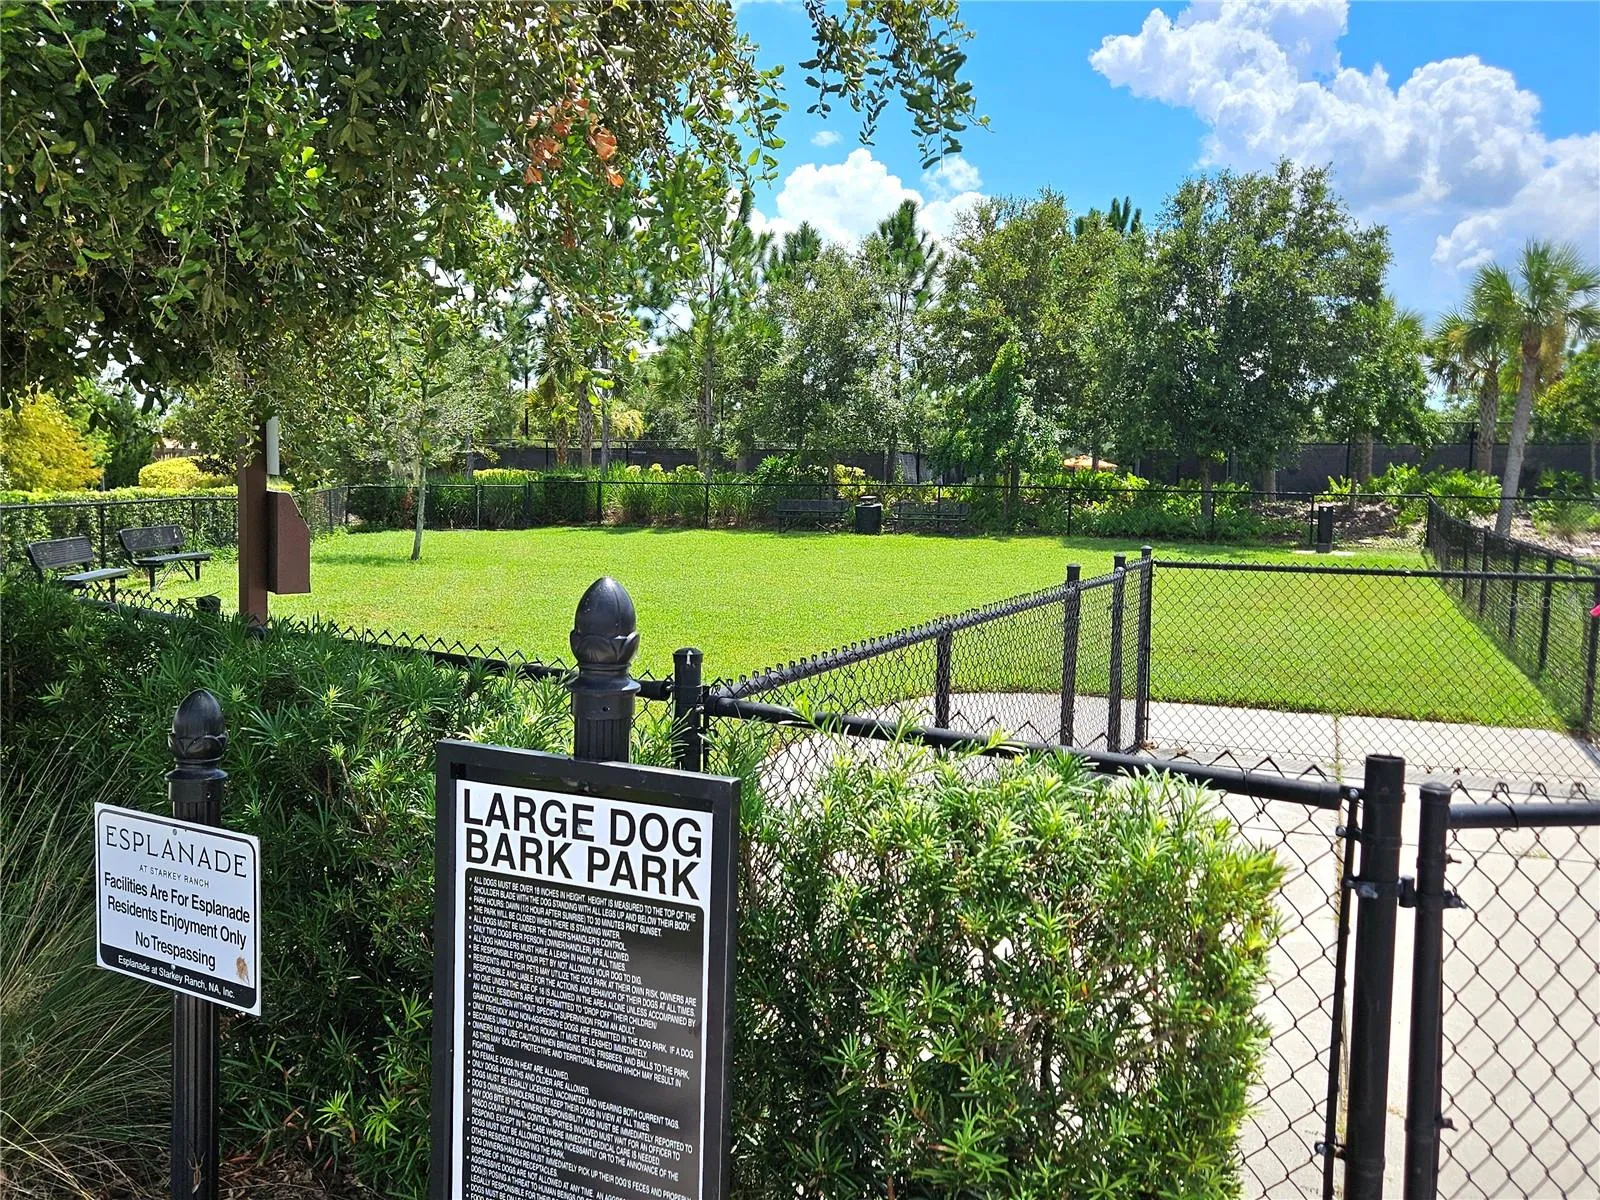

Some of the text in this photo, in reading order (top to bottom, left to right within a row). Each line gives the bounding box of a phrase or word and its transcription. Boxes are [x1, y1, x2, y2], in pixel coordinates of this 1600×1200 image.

[464, 789, 701, 858] LARGE DOG
[106, 825, 247, 878] ESPLANADE
[467, 828, 699, 900] BARK PARK
[139, 864, 209, 888] AT STARKEY RANCH
[105, 872, 250, 923] Facilities Are For Esplanade
[474, 877, 483, 885] ALL
[483, 878, 497, 888] DOGS
[498, 881, 511, 890] MUST
[512, 883, 519, 891] BE
[519, 884, 533, 894] OVER
[541, 888, 559, 898] INCHES
[560, 891, 565, 899] IN
[588, 896, 607, 906] HEIGHT
[608, 899, 613, 907] IS
[614, 900, 644, 912] MEASURED
[645, 905, 652, 914] TO
[653, 907, 664, 916] THE
[664, 908, 675, 918] TOP
[676, 910, 684, 919] OF
[685, 912, 696, 921] THE
[474, 886, 690, 931] SHOULDER BLADE WITH THE DOG STANDING WITH ALL LEGS UP AND BELOW THEIR BODY.
[474, 896, 486, 905] PARK
[506, 902, 519, 911] DAWN
[530, 906, 544, 915] HOUR
[545, 908, 561, 919] AFTER
[562, 911, 586, 923] SUNRISE)
[587, 916, 594, 924] TO
[595, 917, 601, 925] 30
[602, 918, 625, 930] MINUTES
[626, 923, 639, 932] PAST
[640, 925, 662, 936] SUNSET.
[108, 895, 247, 950] Residents Enjoyment Only
[473, 915, 482, 924] ALL
[483, 917, 497, 926] DOGS
[498, 920, 511, 929] MUST
[512, 922, 518, 930] BE
[519, 924, 536, 934] UNDER
[537, 927, 547, 936] THE
[473, 925, 486, 934] ONLY
[486, 927, 497, 936] TWO
[498, 929, 512, 939] DOGS
[513, 932, 523, 941] PER
[524, 934, 544, 945] PERSON
[592, 947, 603, 956] ARE
[474, 905, 621, 939] THE PARK WILL BE CLOSED WHEN THERE IS STANDING WATER.
[136, 931, 215, 971] No Trespassing
[473, 934, 482, 943] ALL
[483, 936, 493, 945] DOG
[494, 938, 519, 950] HANDLERS
[520, 943, 534, 953] MUST
[535, 946, 548, 956] HAVE
[549, 949, 553, 957] A
[554, 950, 570, 960] LEASH
[571, 953, 576, 961] IN
[577, 954, 591, 964] HAND
[592, 957, 598, 966] AT
[599, 959, 609, 968] ALL
[473, 944, 479, 952] BE
[480, 945, 513, 959] RESPONSIBLE
[514, 952, 524, 961] FOR
[525, 954, 538, 964] YOUR
[539, 957, 549, 966] PET
[550, 959, 557, 968] BY
[558, 961, 568, 970] NOT
[569, 963, 595, 975] ALLOWING
[595, 968, 609, 978] YOUR
[611, 971, 623, 981] DOG
[624, 973, 631, 982] TO
[118, 955, 235, 999] Esplanade at Starkey Ranch, NA, Inc.
[472, 1040, 495, 1052] FIGHTING.
[472, 1050, 479, 1058] NO
[480, 1052, 499, 1063] FEMALE
[500, 1056, 513, 1067] DOGS
[514, 1060, 519, 1068] IN
[520, 1061, 533, 1071] HEAT
[533, 1064, 543, 1074] ARE
[472, 1059, 484, 1069] ONLY
[485, 1062, 499, 1073] DOGS
[499, 1066, 502, 1074] 4
[503, 1067, 524, 1079] MONTHS
[525, 1072, 535, 1082] AND
[536, 1075, 552, 1086] OLDER
[553, 1079, 564, 1089] ARE
[472, 1069, 486, 1079] DOGS
[487, 1072, 500, 1083] MUST
[501, 1076, 507, 1085] BE
[508, 1078, 528, 1090] LEGALLY
[555, 1089, 586, 1104] VACCINATED
[587, 1097, 597, 1107] AND
[598, 1100, 622, 1113] WEARING
[623, 1106, 637, 1117] BOTH
[638, 1110, 664, 1124] CURRENT
[665, 1117, 680, 1128] TAGS.
[471, 1126, 487, 1138] OTHER
[488, 1131, 515, 1145] RESIDENTS
[516, 1138, 540, 1152] ENJOYING
[540, 1145, 550, 1155] THE
[471, 1145, 491, 1158] DISPOSE
[492, 1151, 499, 1160] OF
[500, 1153, 505, 1162] IN
[506, 1155, 521, 1166] TRASH
